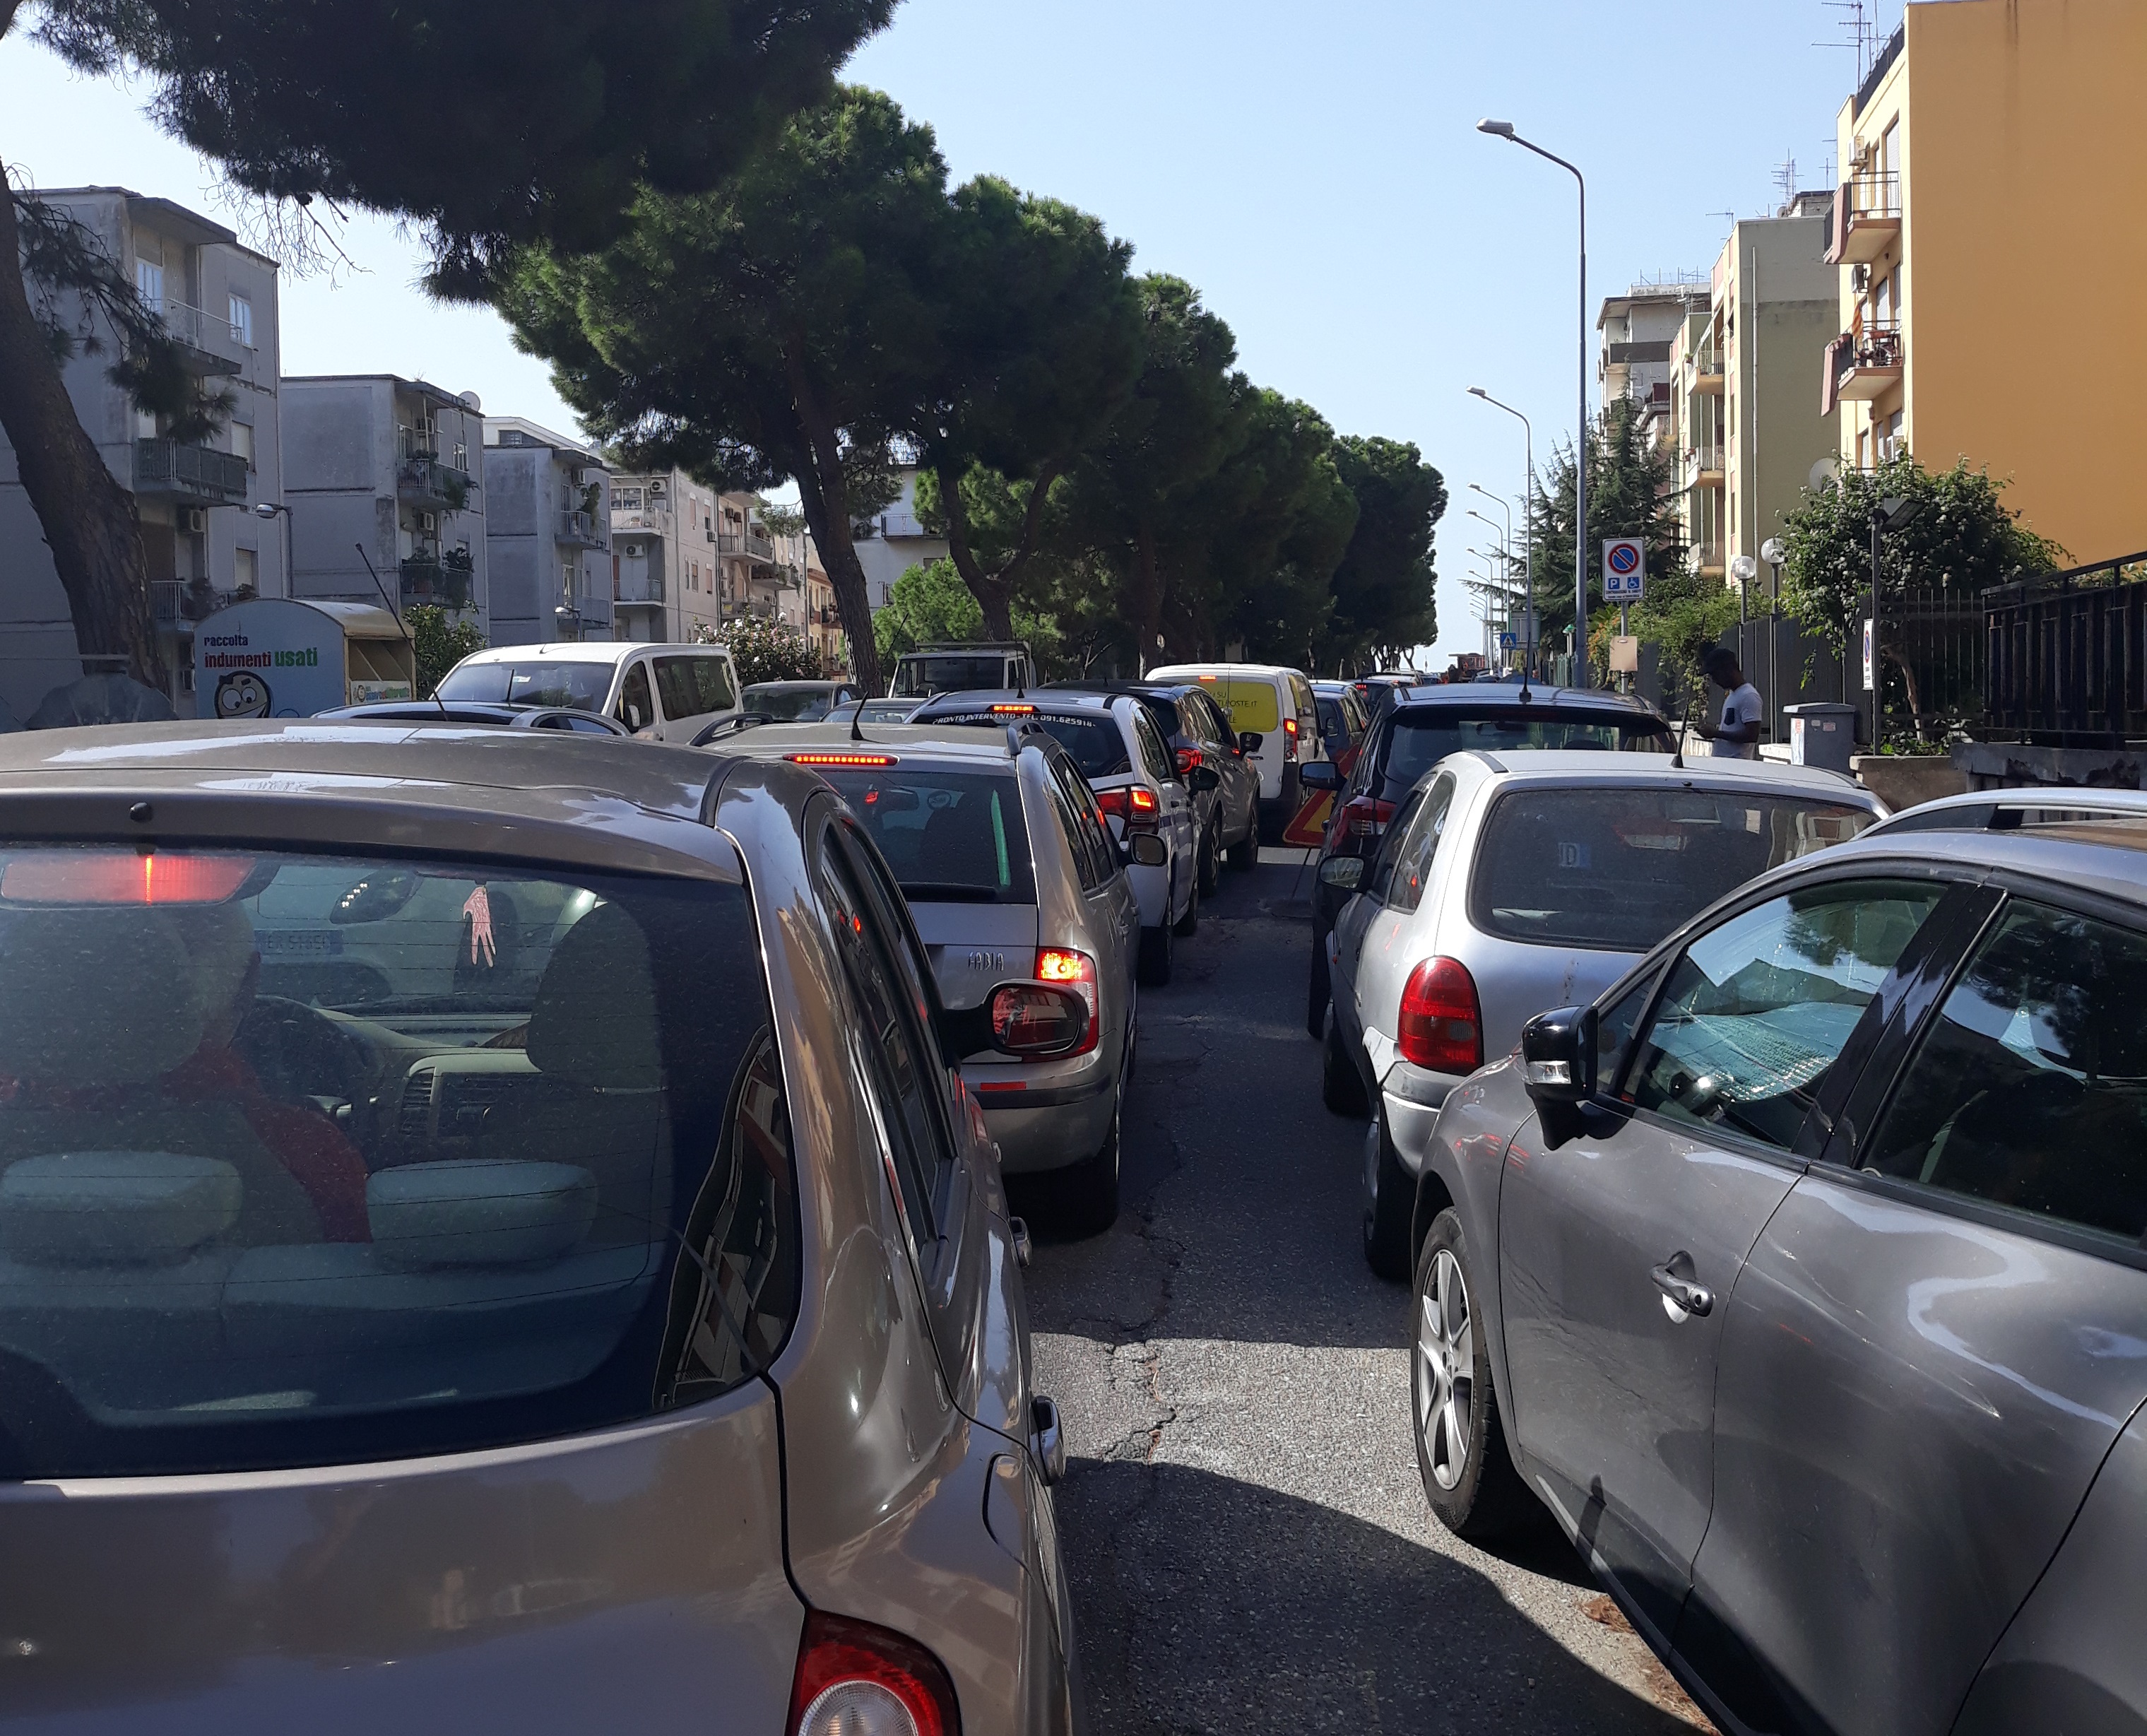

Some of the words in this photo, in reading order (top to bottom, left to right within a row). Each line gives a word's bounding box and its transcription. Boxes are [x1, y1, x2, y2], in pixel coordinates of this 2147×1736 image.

[1610, 579, 1618, 589] P
[203, 634, 248, 646] raccolta
[205, 651, 271, 668] indumenti
[274, 646, 318, 667] usati
[933, 714, 964, 725] PRONTO
[968, 951, 1004, 972] FABIA
